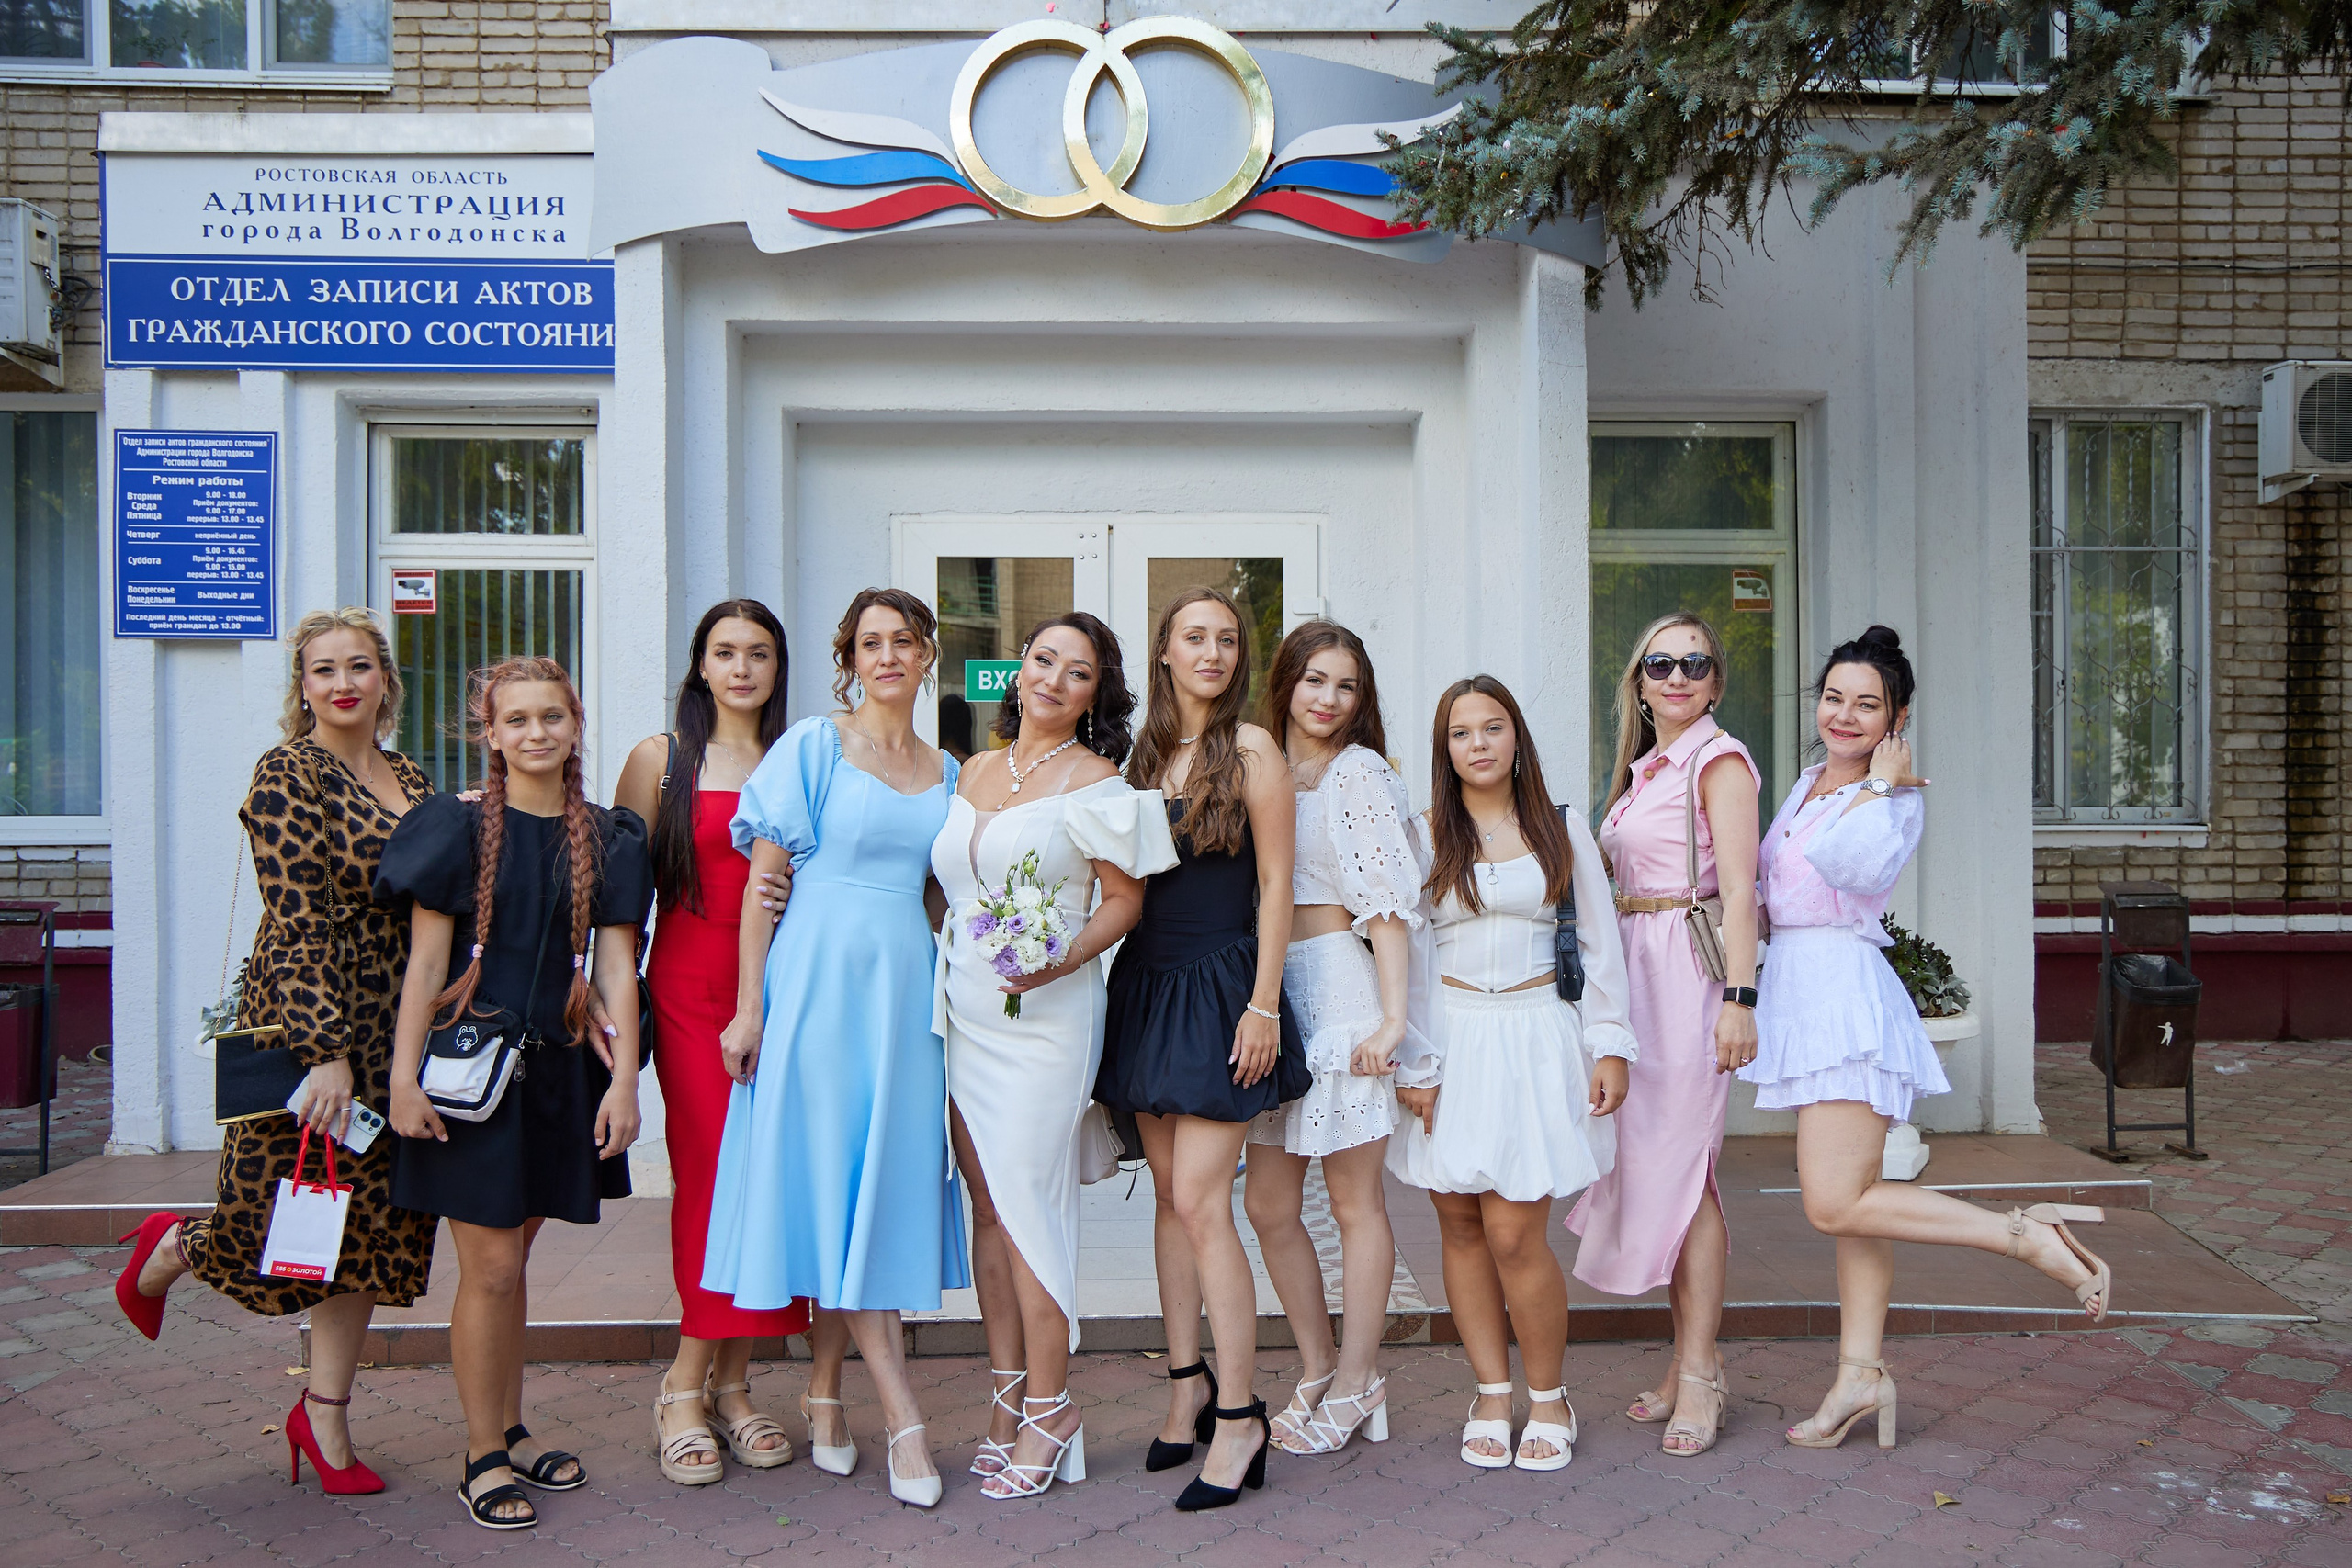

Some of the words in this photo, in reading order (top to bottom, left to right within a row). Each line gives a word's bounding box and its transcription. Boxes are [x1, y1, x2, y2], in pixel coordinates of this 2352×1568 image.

[256, 168, 396, 183] РОСТОВСКАЯ
[412, 171, 507, 184] ОБЛАСТЬ
[203, 192, 564, 222] АДМИНИСТРАЦИЯ
[202, 223, 322, 244] города
[342, 216, 565, 243] Волгодонска
[171, 277, 291, 306] ОТДЕЛ
[308, 279, 458, 304] ЗАПИСИ
[474, 281, 593, 305] АКТОВ
[129, 319, 411, 348] ГРАЖДАНСКОГО
[123, 437, 142, 446] Отдел
[188, 439, 233, 447] гражданского
[235, 439, 267, 447] состояния
[137, 447, 187, 457] Администрации
[188, 449, 210, 457] города
[212, 448, 254, 457] Волгодонска
[163, 457, 199, 466] Ростовской
[201, 458, 227, 467] области
[153, 475, 194, 485] Режим
[198, 476, 243, 487] работы
[127, 492, 162, 502] Вторник
[132, 502, 157, 511] Среда
[206, 506, 221, 514] 9.00
[127, 512, 162, 520] Пятница
[127, 531, 160, 539] Четверг
[128, 557, 161, 565] Суббота
[193, 555, 215, 563] Приём
[128, 585, 175, 594] Воскресенье
[127, 595, 175, 604] Понедельник
